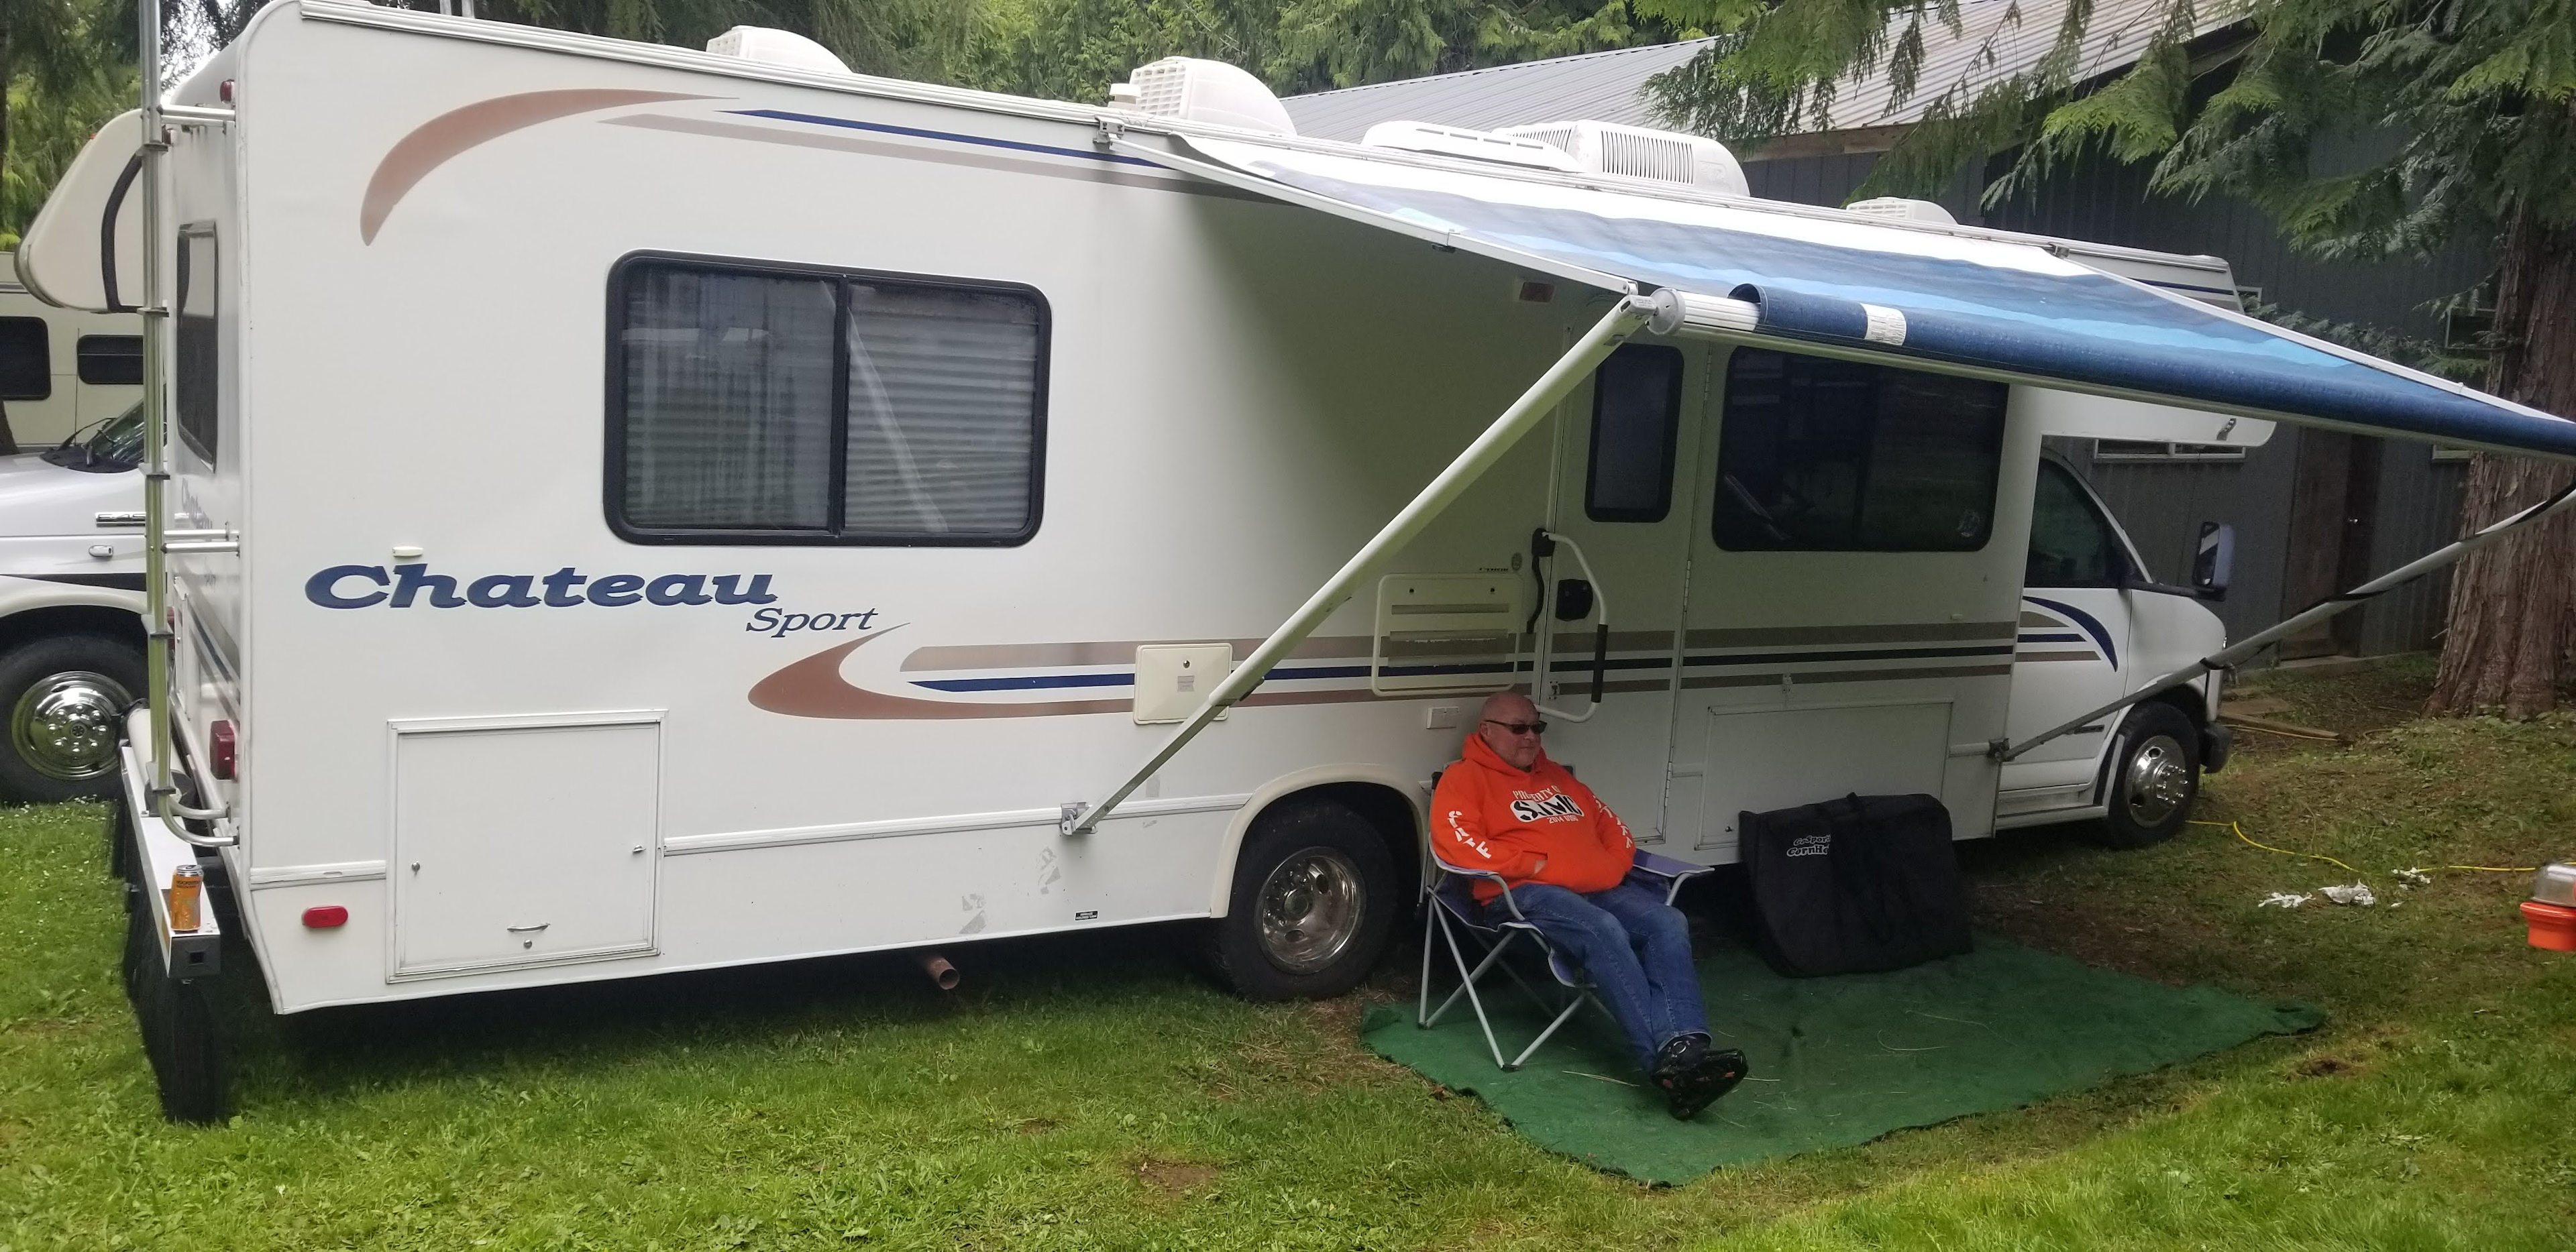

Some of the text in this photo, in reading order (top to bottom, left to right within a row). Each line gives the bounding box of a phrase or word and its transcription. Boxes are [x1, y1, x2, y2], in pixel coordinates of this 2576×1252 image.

[305, 563, 778, 608] Chateau
[746, 608, 879, 638] Sport
[1547, 815, 1564, 824] 2014
